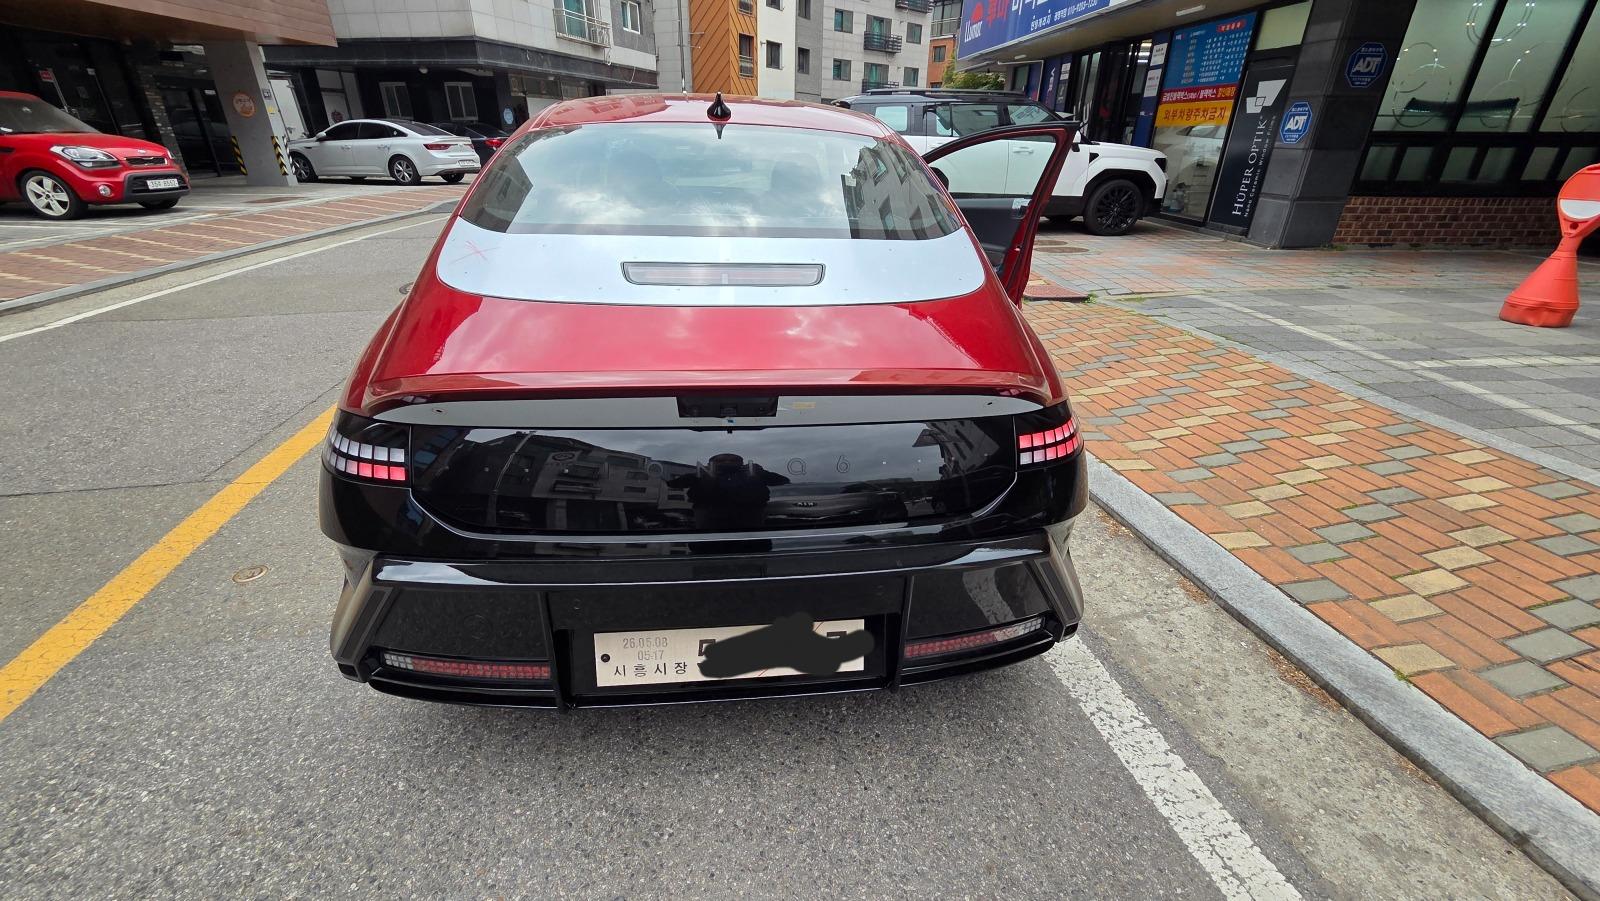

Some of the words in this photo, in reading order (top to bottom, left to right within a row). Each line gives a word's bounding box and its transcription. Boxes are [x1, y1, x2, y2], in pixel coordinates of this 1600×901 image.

[1352, 57, 1381, 72] ADT
[1285, 115, 1308, 131] ADT
[1232, 167, 1254, 216] HÜPER
[1248, 119, 1268, 164] OPTIK
[614, 661, 688, 678] 시흥시장
